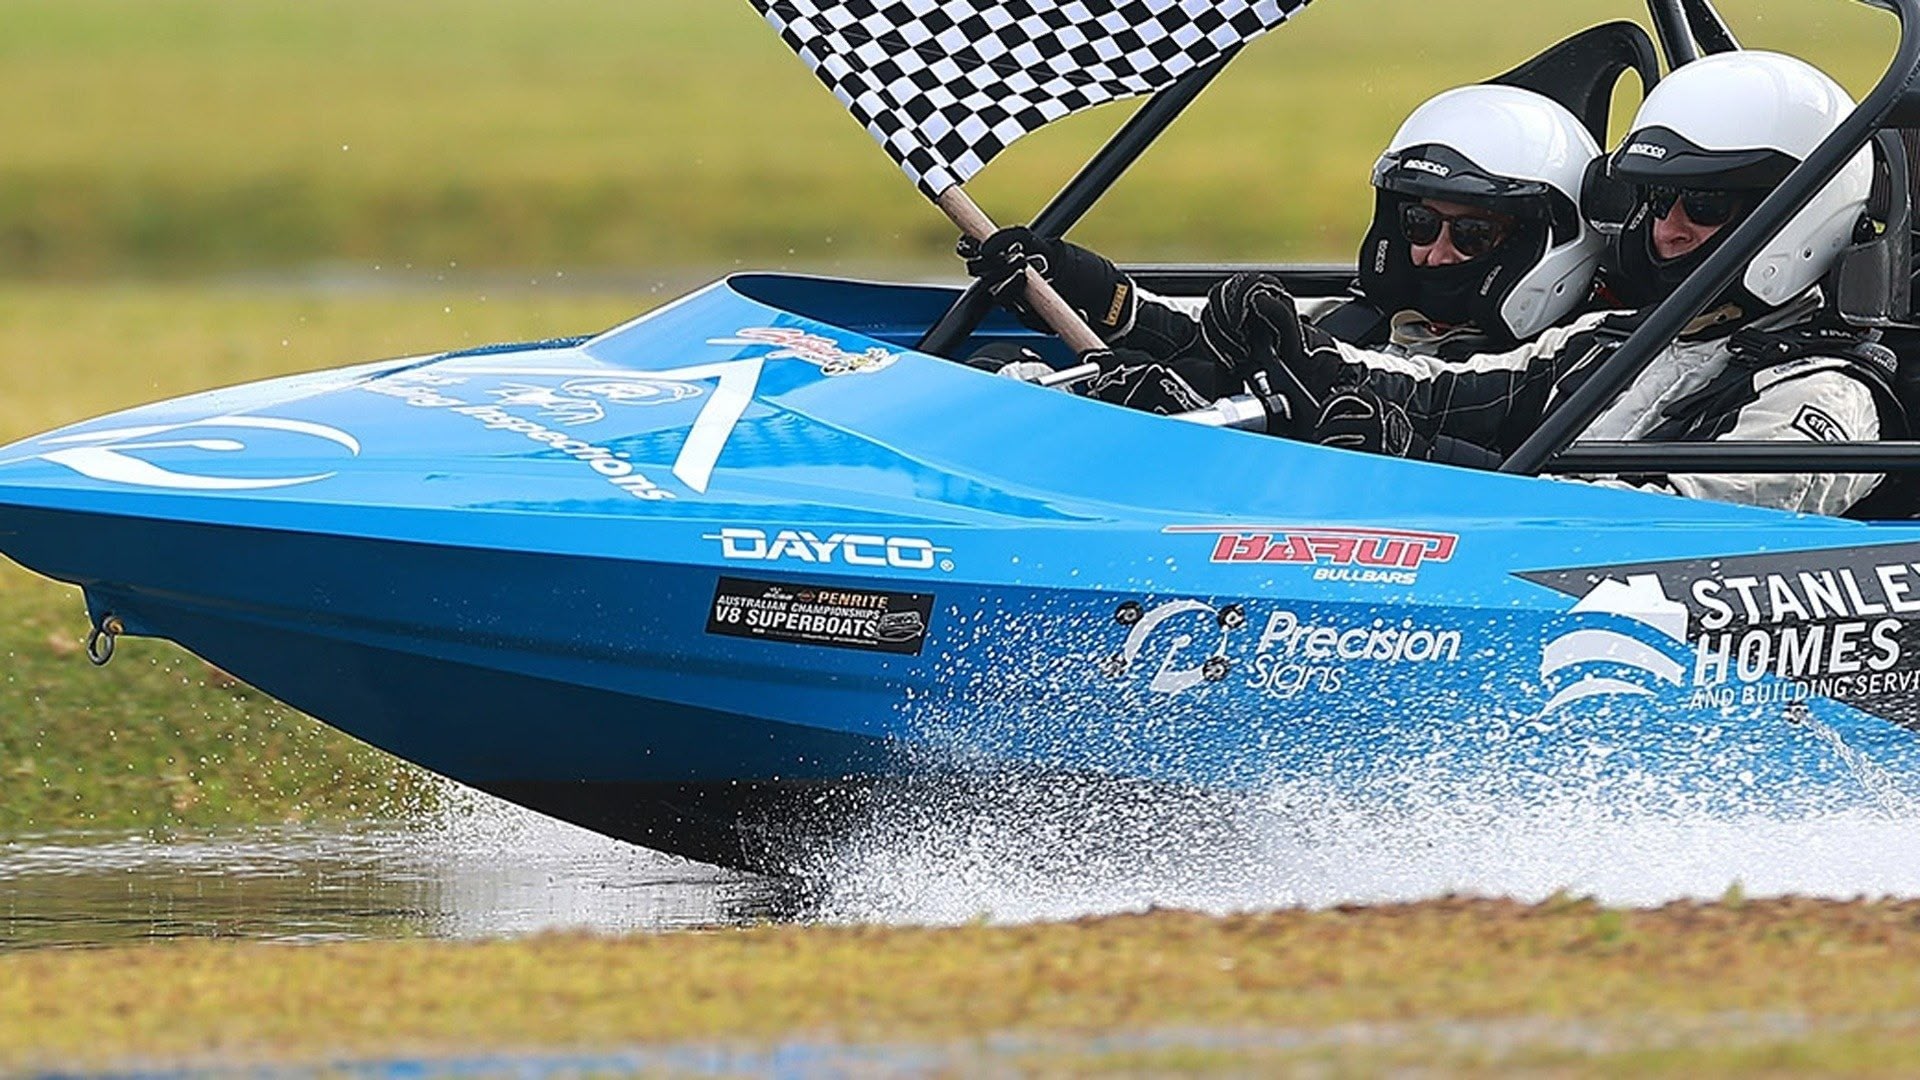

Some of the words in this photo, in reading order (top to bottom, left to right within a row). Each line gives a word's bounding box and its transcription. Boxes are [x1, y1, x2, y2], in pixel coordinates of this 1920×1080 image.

[719, 527, 935, 570] DAYCO
[1312, 567, 1417, 586] BULLBARS
[716, 594, 787, 612] AUSTRALIAN
[790, 602, 881, 621] CHAMPIONSHIPS
[817, 590, 889, 609] PENRITE
[1691, 562, 1920, 631] STANLE
[714, 604, 742, 624] V8
[744, 608, 878, 639] SUPERBOATS
[1256, 610, 1462, 662] Precision
[1692, 617, 1904, 688] HOMES
[1245, 653, 1347, 698] Signs
[1689, 687, 1735, 710] AND
[1741, 677, 1847, 705] BUILDING
